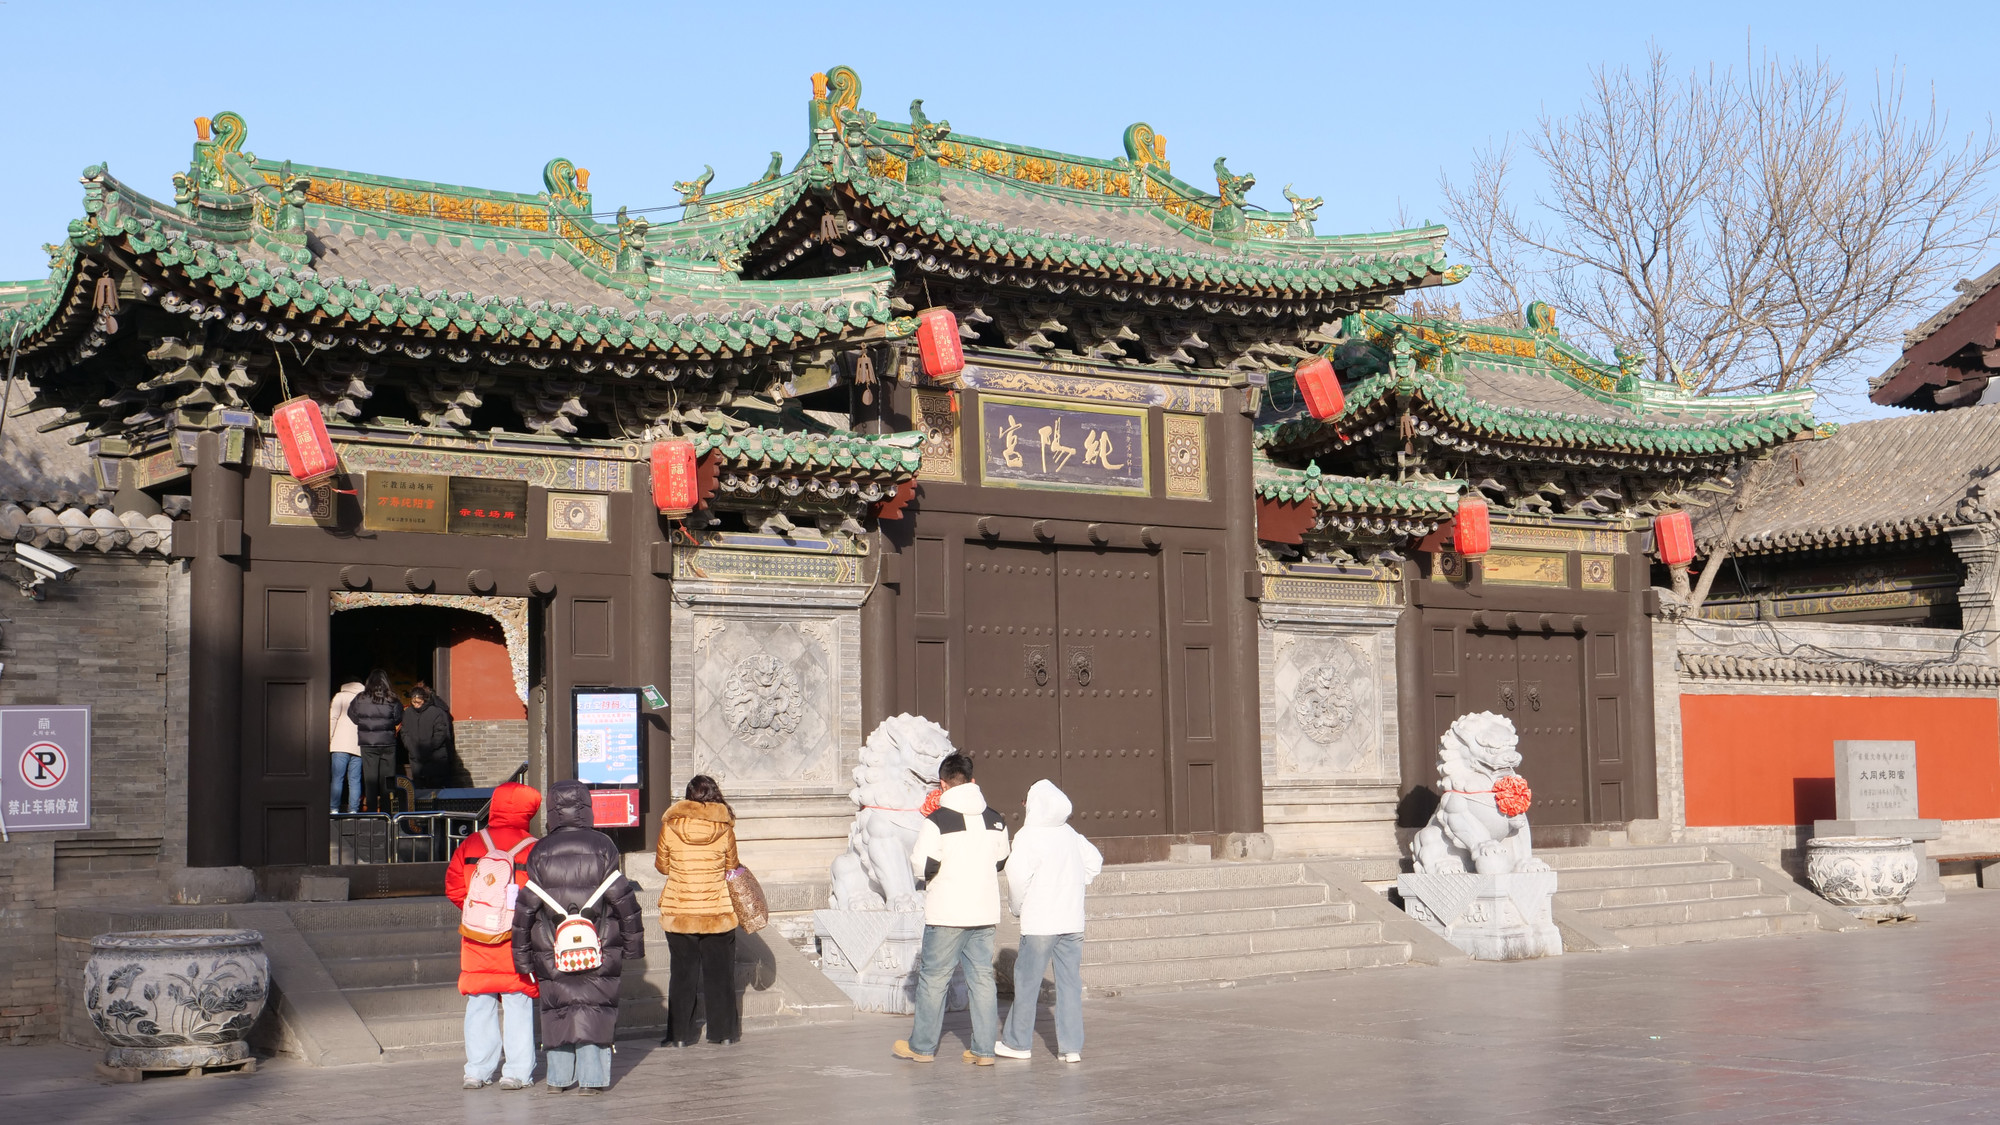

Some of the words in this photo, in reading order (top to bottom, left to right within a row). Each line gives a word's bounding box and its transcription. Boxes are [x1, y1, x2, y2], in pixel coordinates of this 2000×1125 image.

[381, 480, 434, 491] 宗教活动场所
[459, 508, 516, 520] 示范场所
[1860, 770, 1906, 780] 大同纯阳宫
[8, 798, 79, 816] 禁止车辆停放
